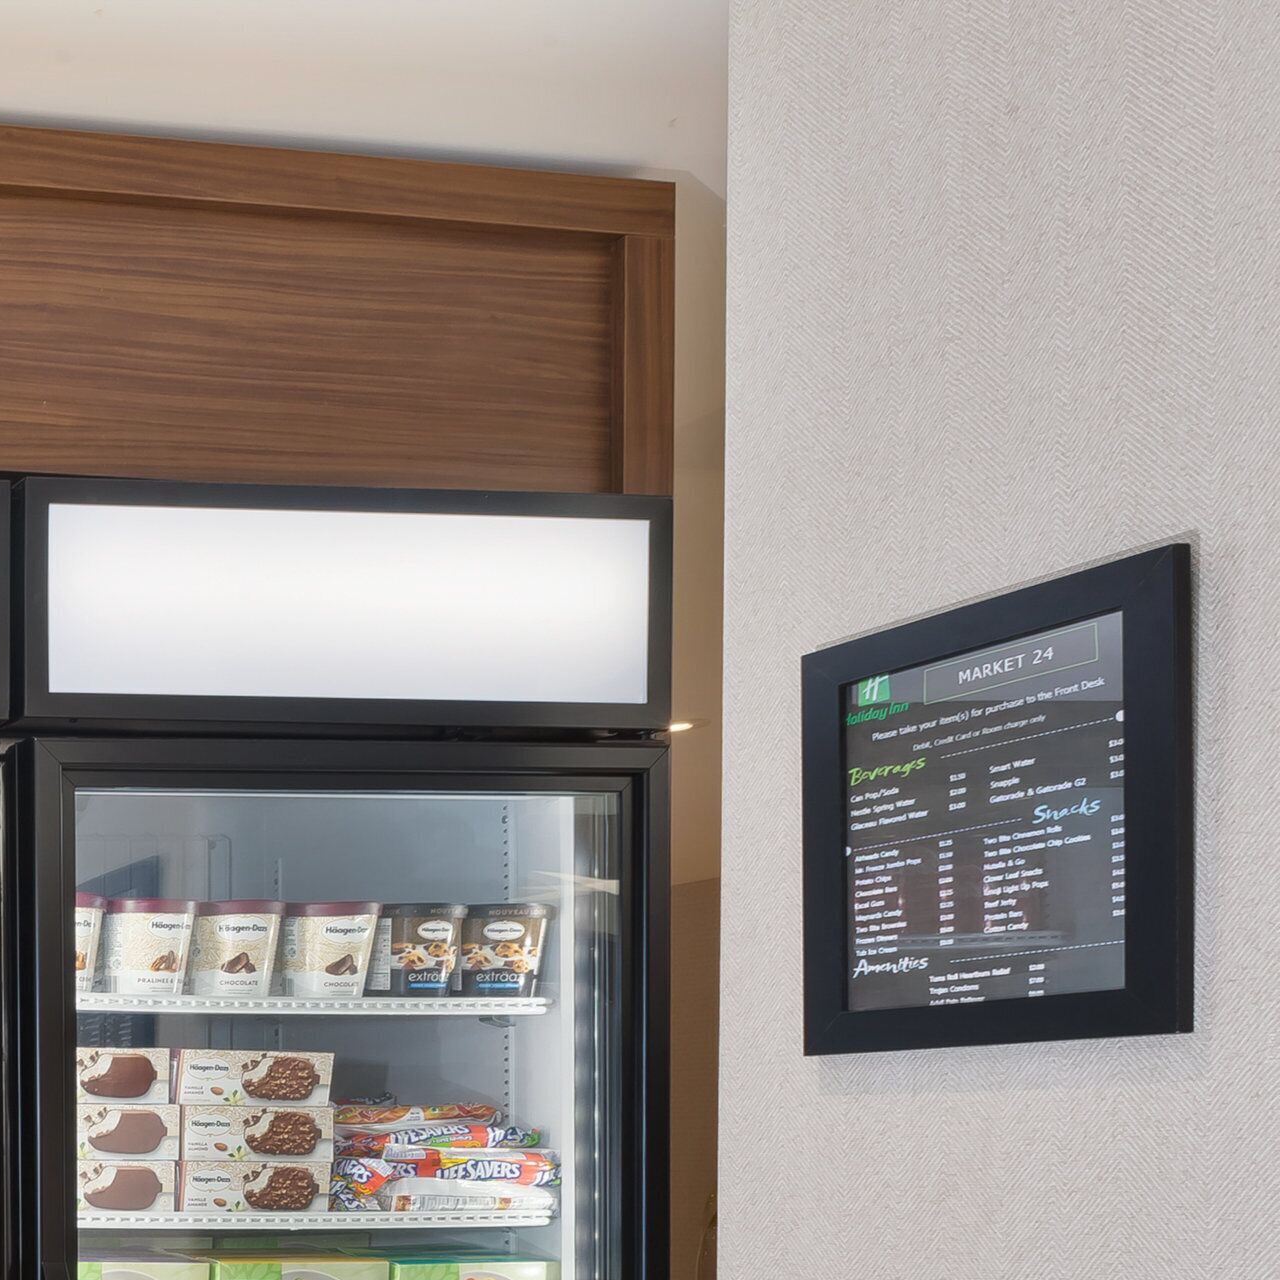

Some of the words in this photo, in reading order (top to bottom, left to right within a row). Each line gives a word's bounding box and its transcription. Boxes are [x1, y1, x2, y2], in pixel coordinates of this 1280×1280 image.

[958, 654, 1026, 684] MARKET
[1032, 646, 1054, 665] 24
[872, 729, 897, 741] Please
[900, 724, 917, 735] take
[918, 720, 937, 731] your
[939, 711, 969, 725] item(s)
[971, 708, 983, 718] for
[985, 698, 1024, 716] purchase
[1026, 696, 1035, 704] to
[1038, 690, 1052, 701] the
[1055, 684, 1079, 696] Front
[1081, 677, 1105, 690] Desk
[889, 702, 909, 715] Inn
[955, 731, 972, 741] Card
[849, 757, 926, 786] Beverages
[1012, 758, 1036, 768] Water
[989, 791, 1025, 804] Gatorade
[1035, 781, 1072, 795] Gatorade
[1032, 797, 1101, 824] Snacks
